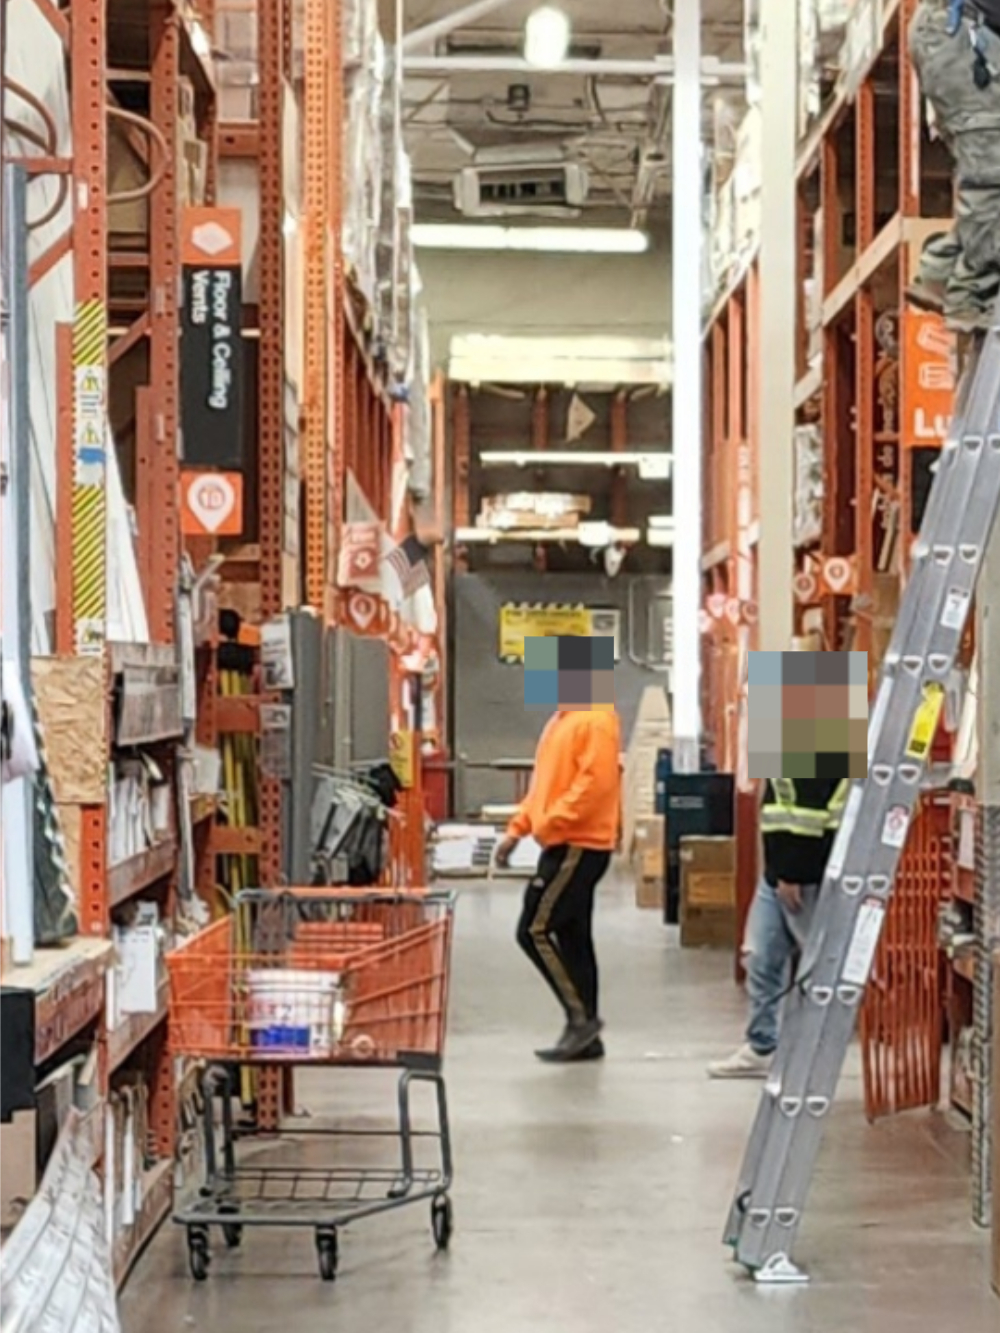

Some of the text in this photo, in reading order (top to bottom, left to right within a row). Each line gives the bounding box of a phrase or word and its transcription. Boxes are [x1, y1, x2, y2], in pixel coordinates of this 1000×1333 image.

[191, 269, 210, 324] Vents
[208, 270, 231, 409] Floor & Ceiling
